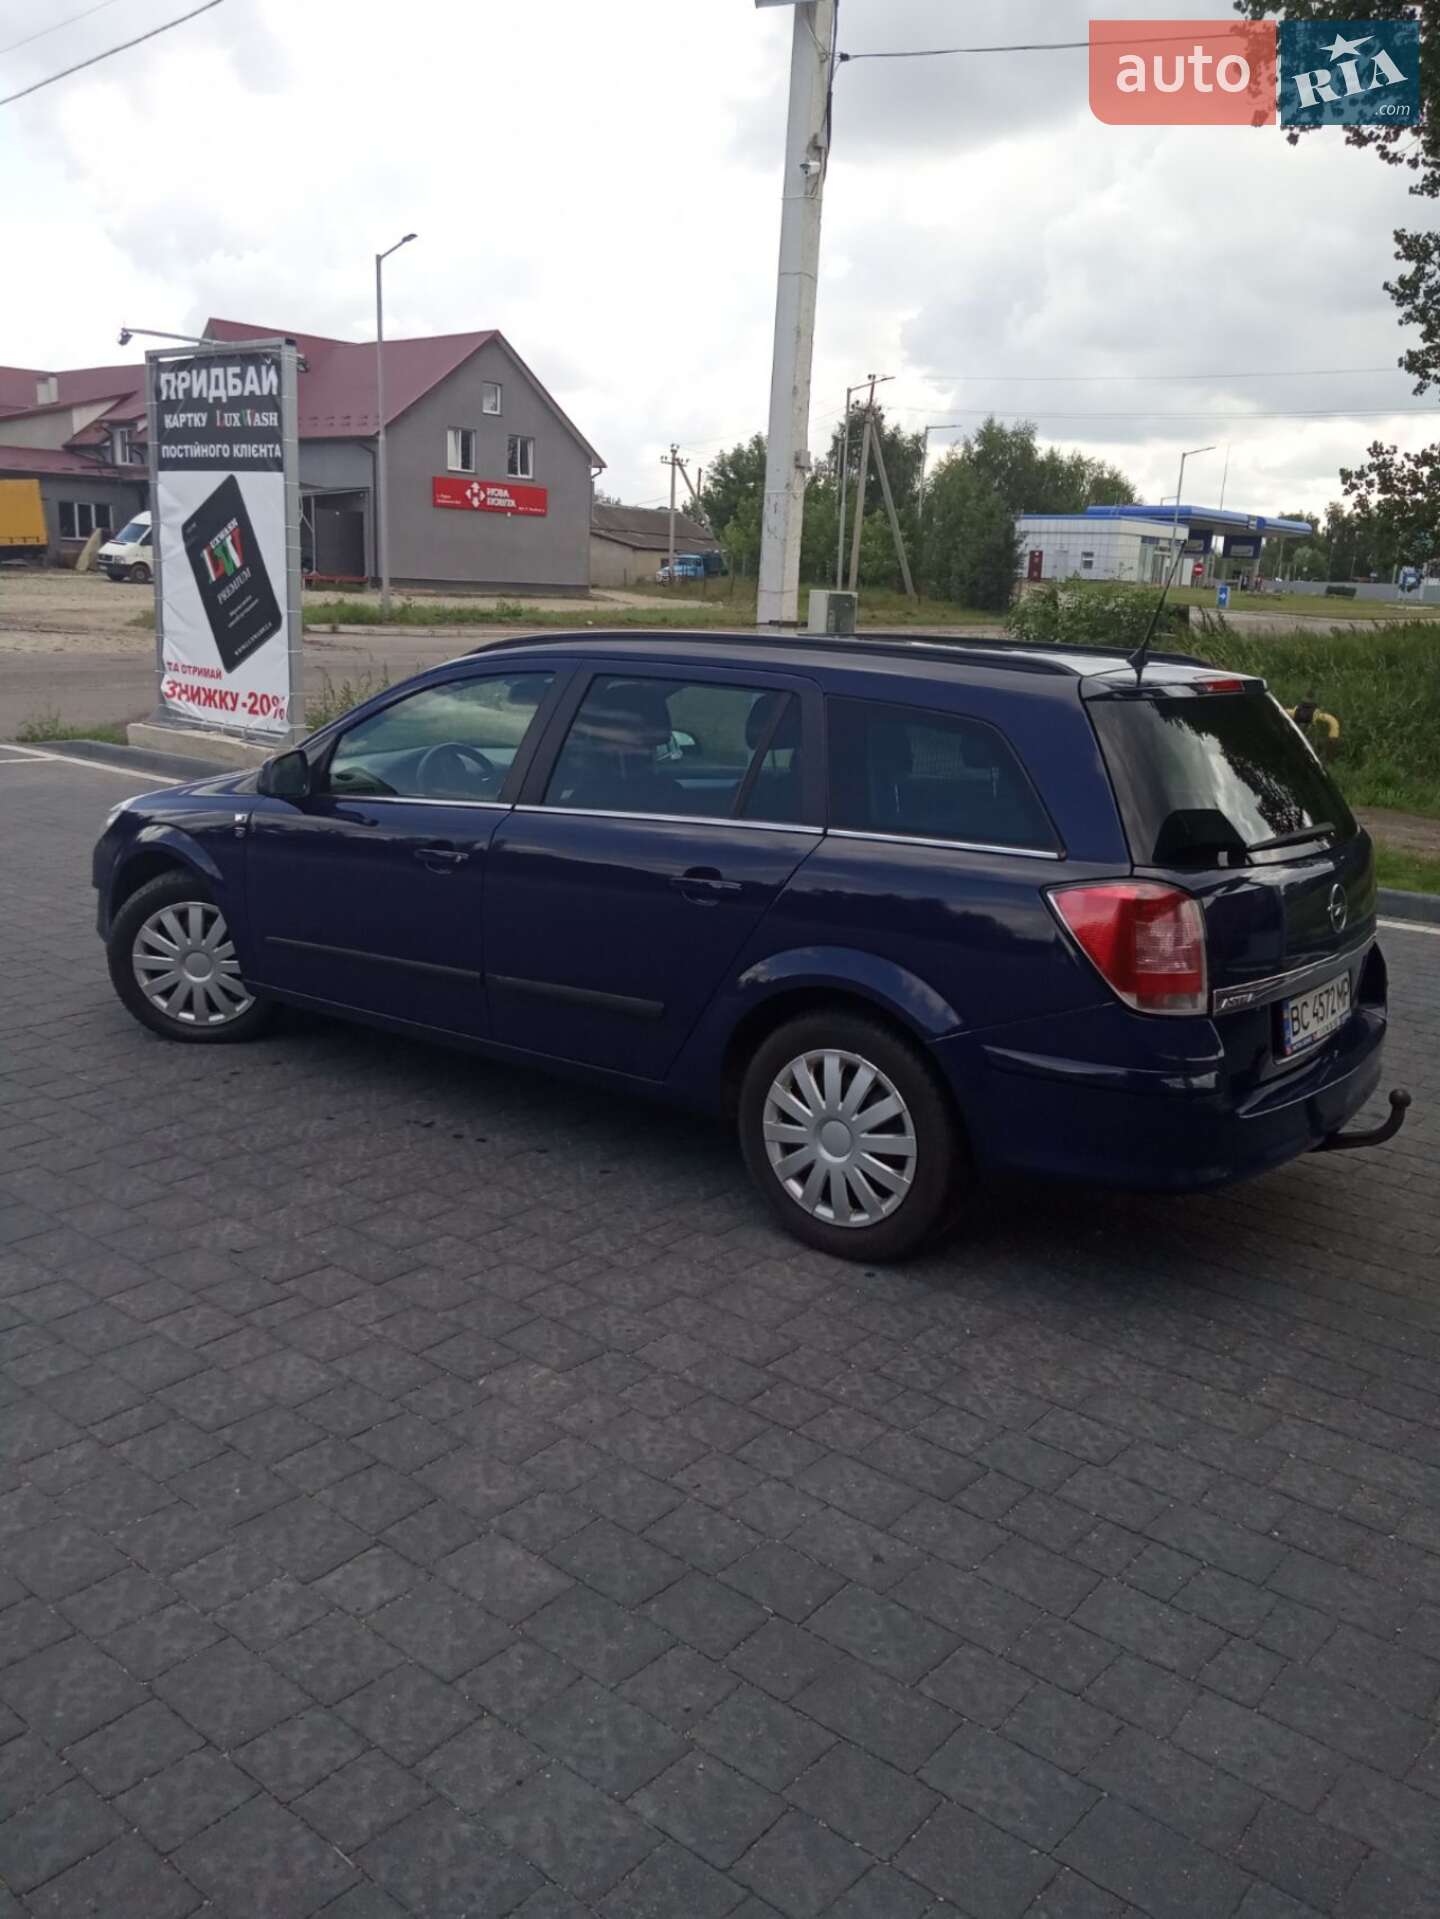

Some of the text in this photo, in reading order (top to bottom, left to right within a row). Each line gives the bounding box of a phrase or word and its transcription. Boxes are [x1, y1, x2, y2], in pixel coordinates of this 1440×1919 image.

[160, 358, 279, 403] ПРИДБАЙ
[163, 411, 208, 428] КАРТКУ
[161, 441, 282, 459] ПОСТІЙНОГО КЛІЄНТА
[166, 661, 223, 681] ТА ОТРИМАЙ
[163, 680, 286, 721] ЗНИЖКУ -20%
